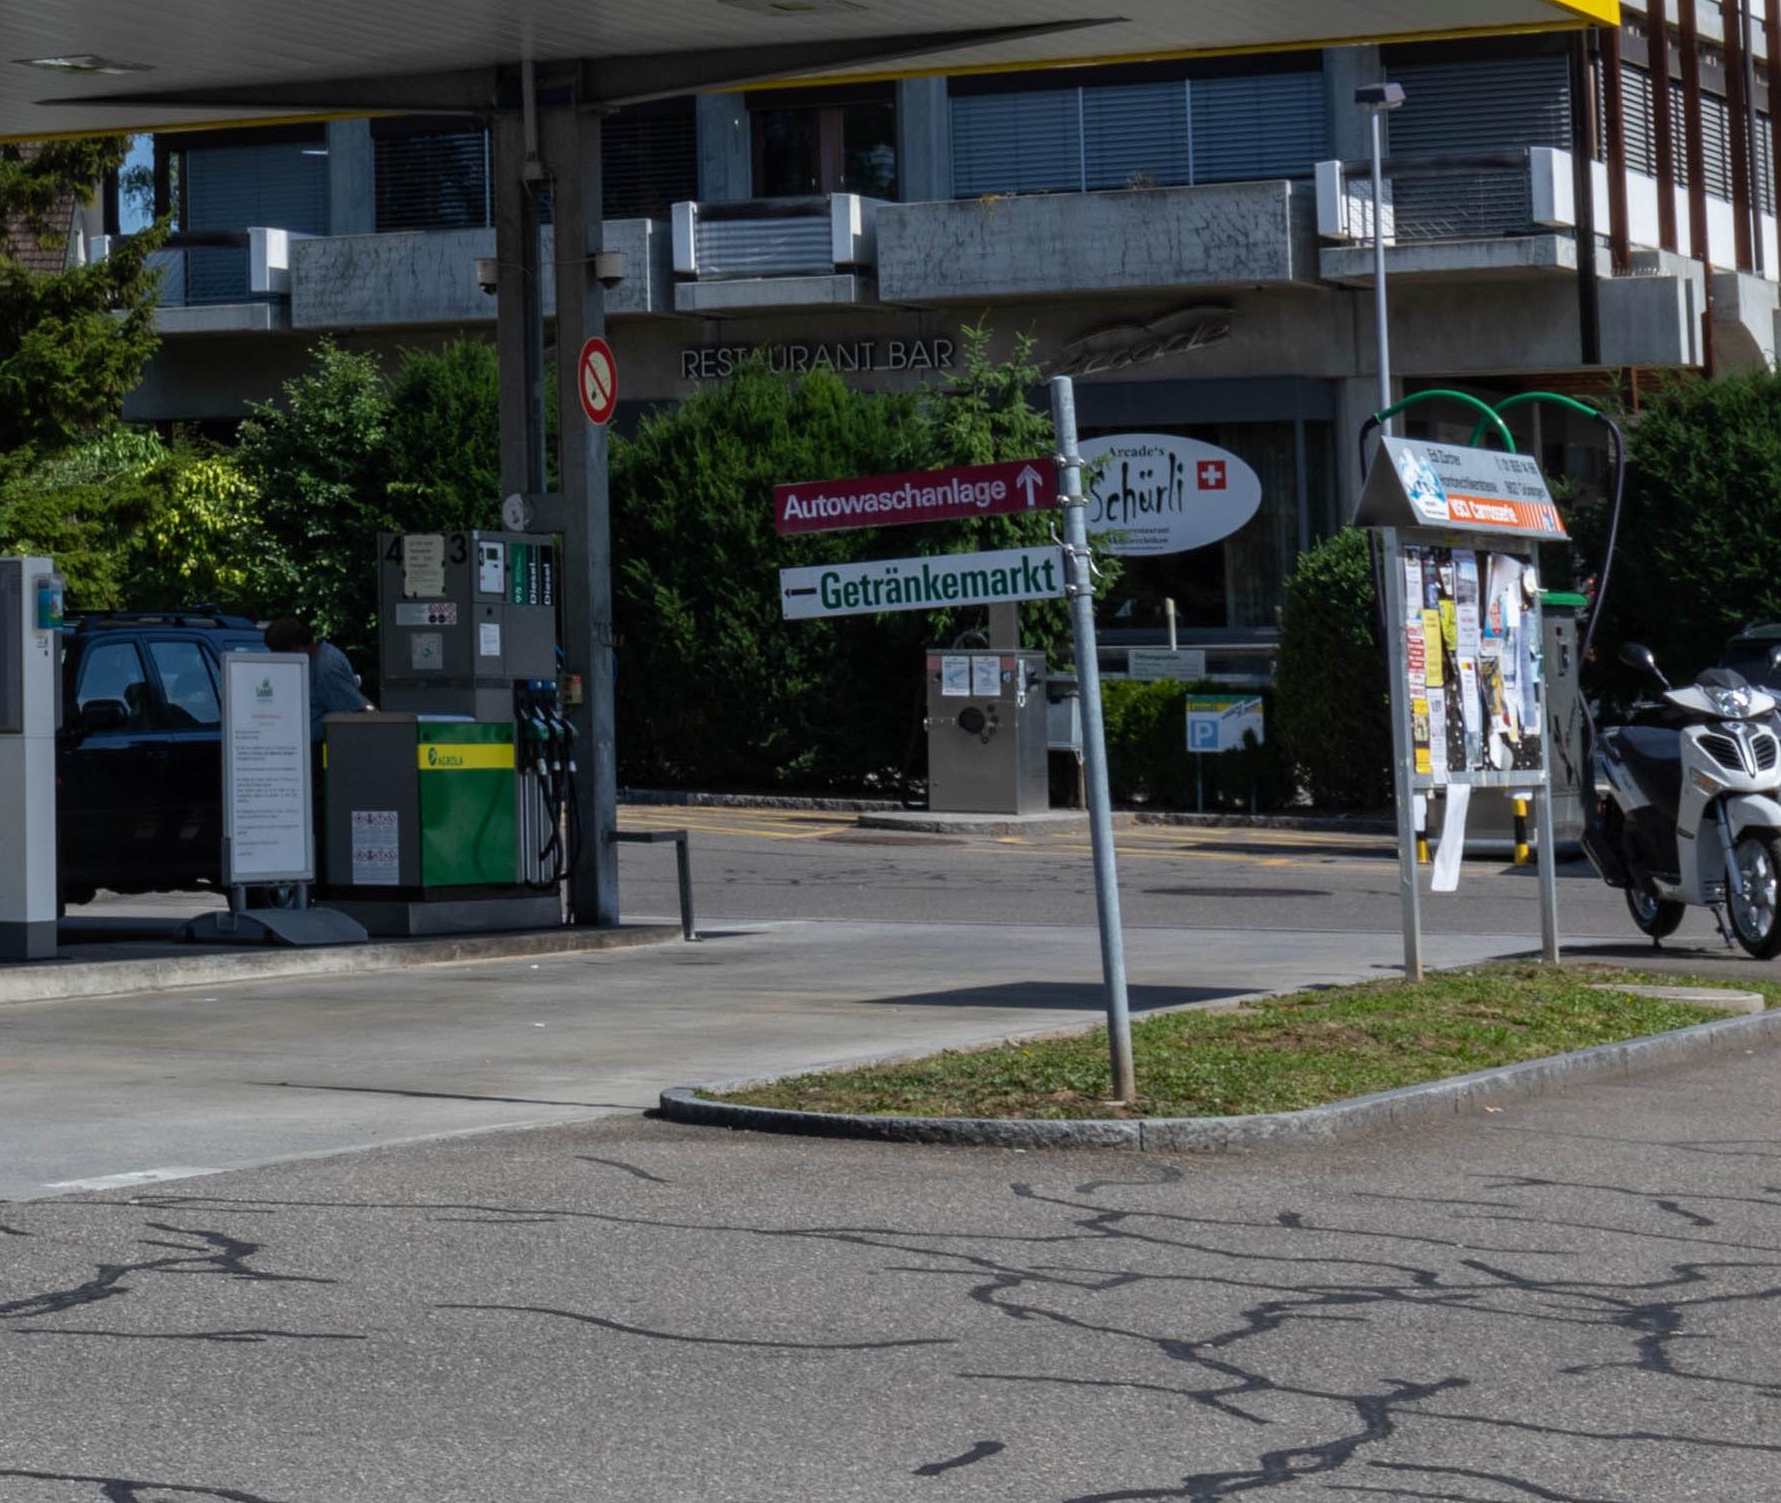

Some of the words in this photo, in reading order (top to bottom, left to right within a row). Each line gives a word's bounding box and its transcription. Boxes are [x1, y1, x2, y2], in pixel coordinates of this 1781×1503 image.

[680, 341, 875, 379] RESTAURANT
[888, 338, 954, 370] BAR
[782, 478, 1007, 523] Autowaschanlage
[1089, 452, 1184, 524] Schürli
[386, 536, 404, 566] 4
[450, 534, 467, 565] 3
[528, 562, 538, 605] Diesel
[542, 563, 552, 606] Diesel
[821, 554, 1058, 611] Getränkemarkt
[1194, 722, 1214, 746] P
